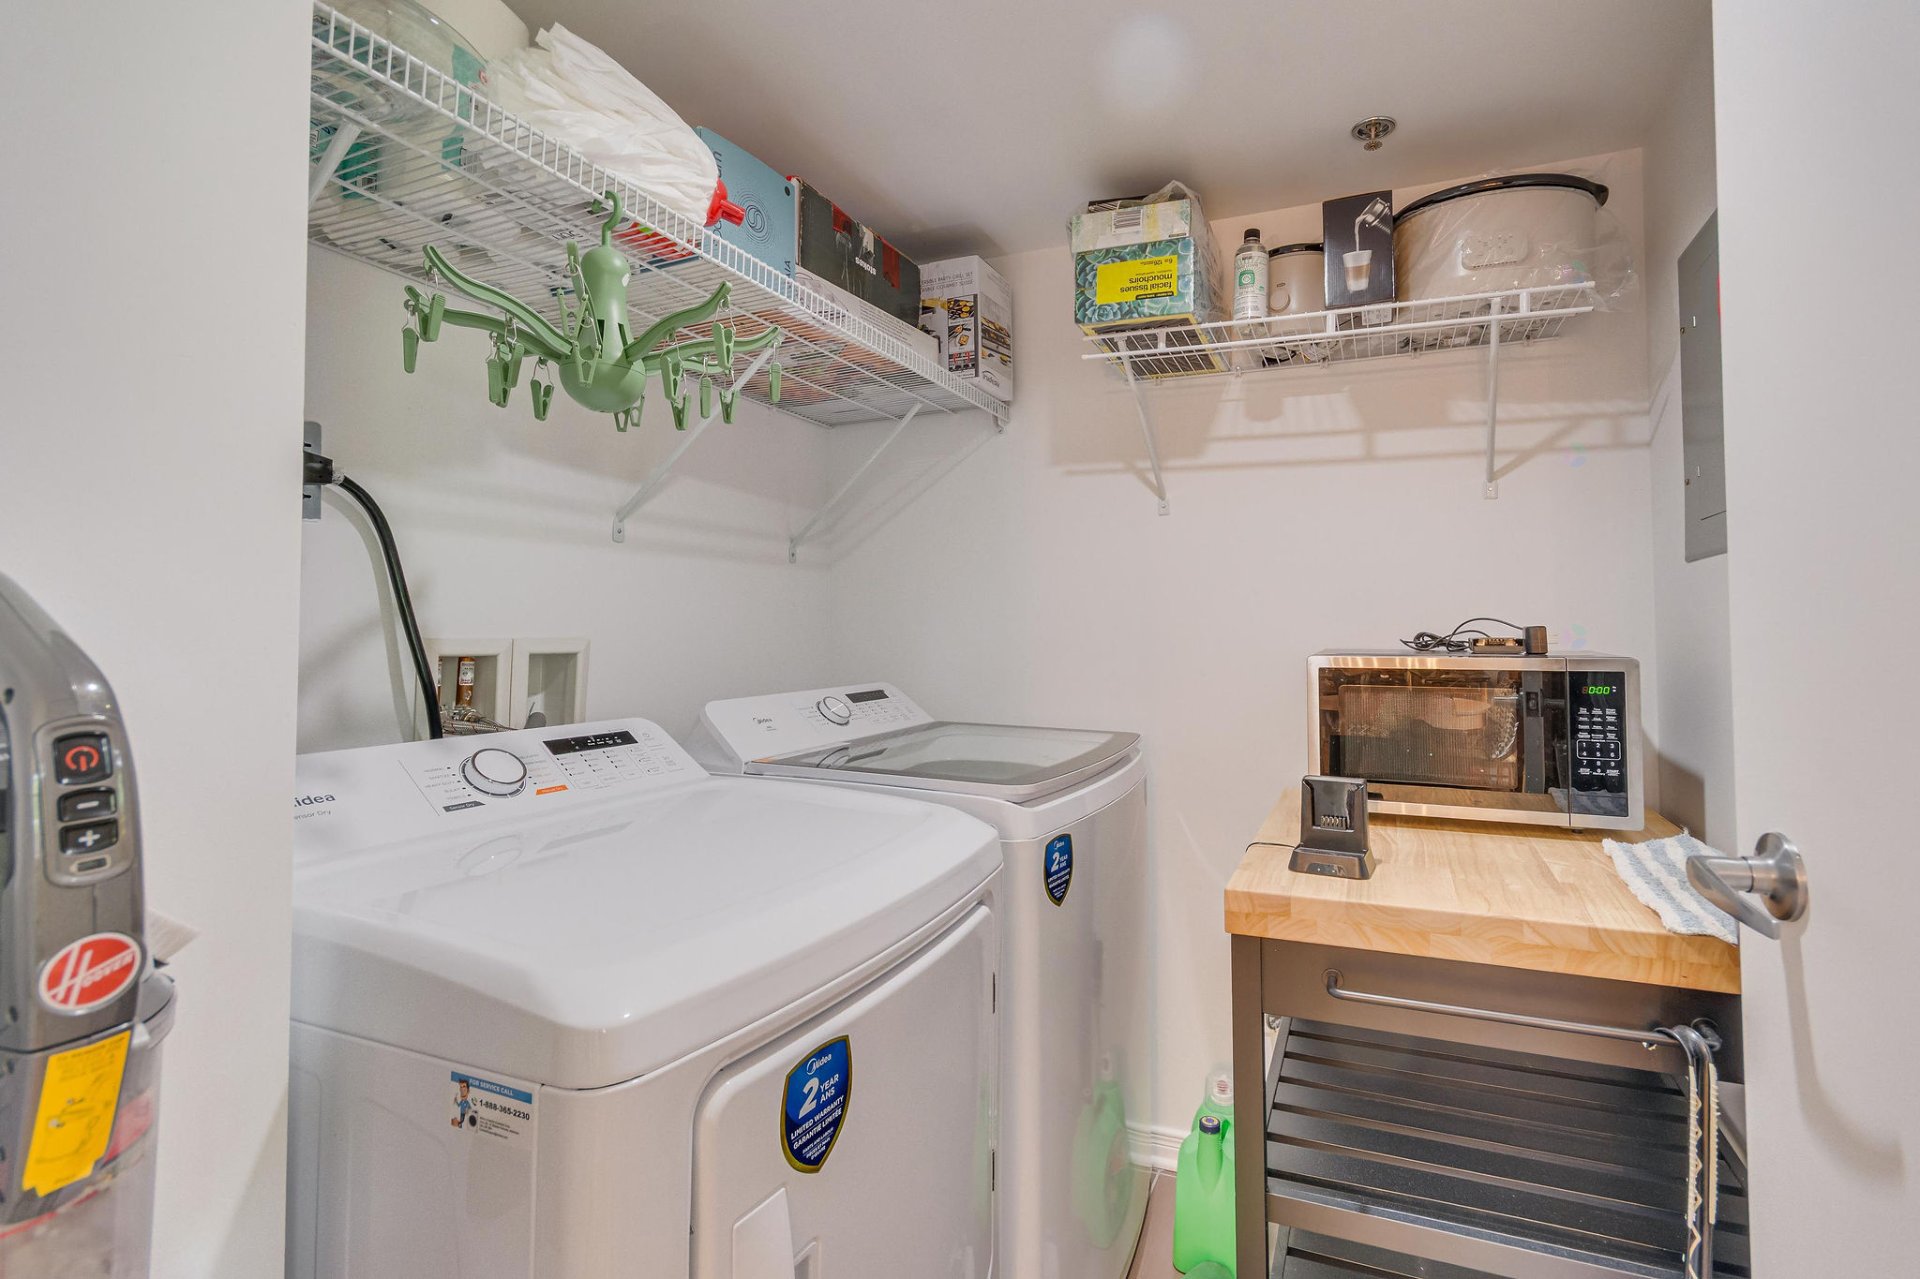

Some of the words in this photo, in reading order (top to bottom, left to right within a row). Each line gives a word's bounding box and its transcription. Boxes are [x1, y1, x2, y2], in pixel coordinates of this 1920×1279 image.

[855, 256, 876, 276] stokes
[1120, 284, 1148, 292] tissues
[1129, 273, 1172, 284] mouchoirs
[1150, 281, 1172, 292] facial
[294, 793, 336, 808] idea
[294, 811, 316, 820] ensor
[317, 809, 332, 818] Dry
[1050, 852, 1060, 872] 2
[806, 1053, 832, 1076] Midea
[480, 1081, 500, 1092] SERVICE
[500, 1088, 514, 1096] CALL
[820, 1074, 839, 1093] YEAR
[798, 1076, 820, 1120] 2
[820, 1086, 835, 1104] ANS
[480, 1099, 530, 1120] 1-888-365-2230
[790, 1118, 814, 1140] LIMITED
[814, 1095, 844, 1122] WARRANTY
[793, 1123, 822, 1150] GARANTIE
